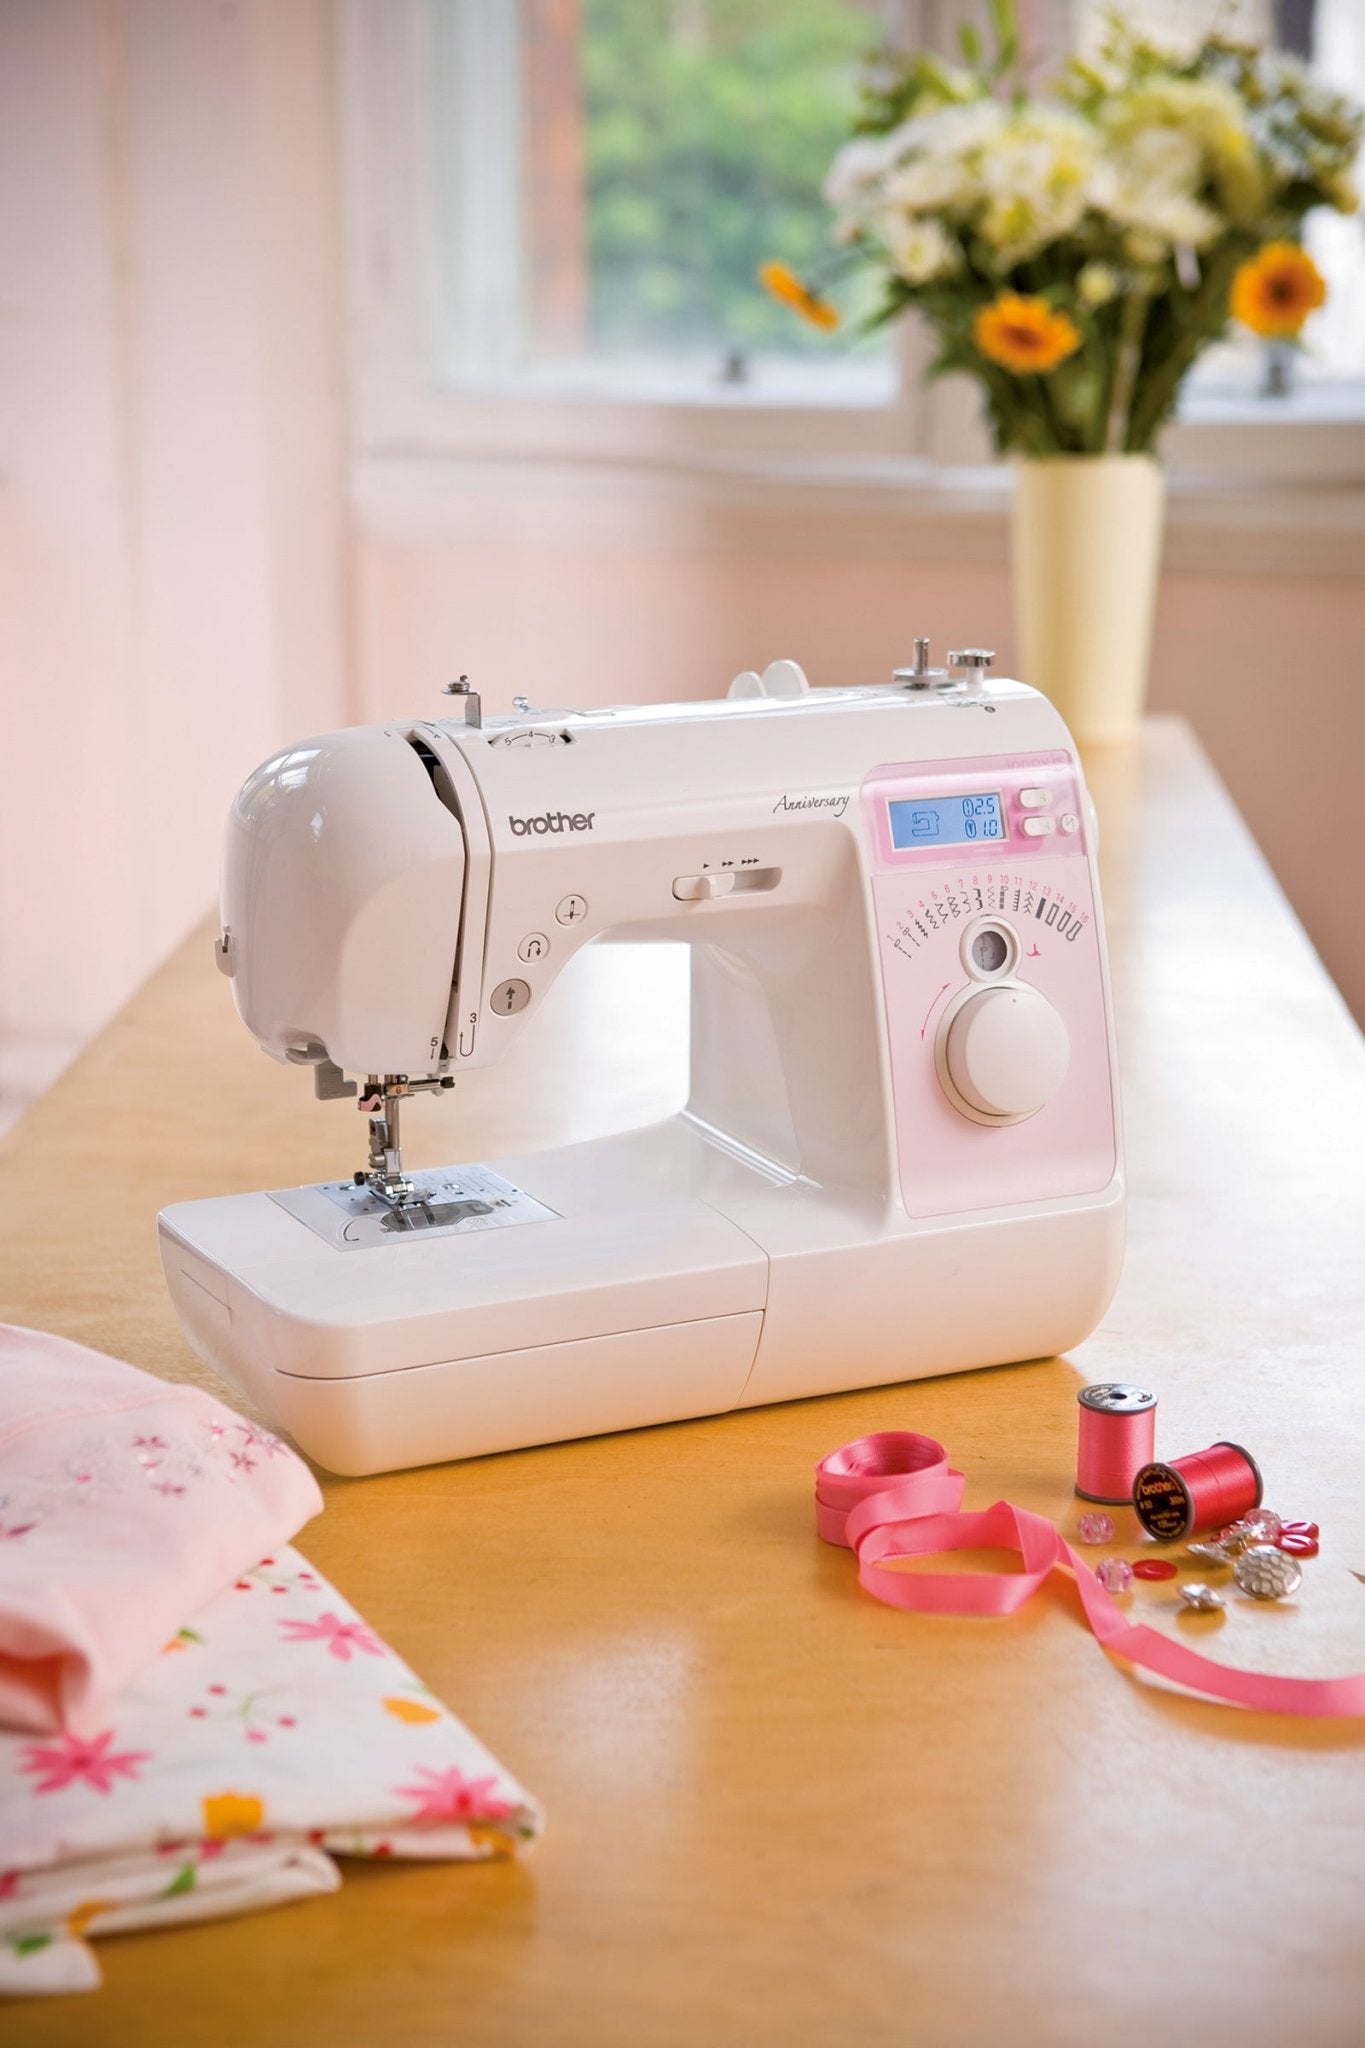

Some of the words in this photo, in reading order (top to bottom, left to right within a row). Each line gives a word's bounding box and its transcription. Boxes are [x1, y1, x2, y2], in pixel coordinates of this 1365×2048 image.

[504, 737, 512, 747] 5
[527, 730, 534, 738] 4
[549, 735, 556, 744] 3
[772, 795, 850, 818] Anniversary
[508, 812, 595, 836] brother
[930, 891, 938, 900] 5
[944, 884, 951, 893] 6
[972, 875, 979, 885] 8
[987, 874, 993, 883] 9
[1000, 874, 1009, 884] 10
[1014, 876, 1023, 886] 11
[1029, 880, 1038, 891] 12
[1042, 886, 1052, 897] 13
[1056, 893, 1065, 905] 14
[1068, 902, 1078, 913] 15
[1080, 912, 1089, 923] 16
[469, 1012, 477, 1024] 3
[430, 1036, 439, 1047] 5
